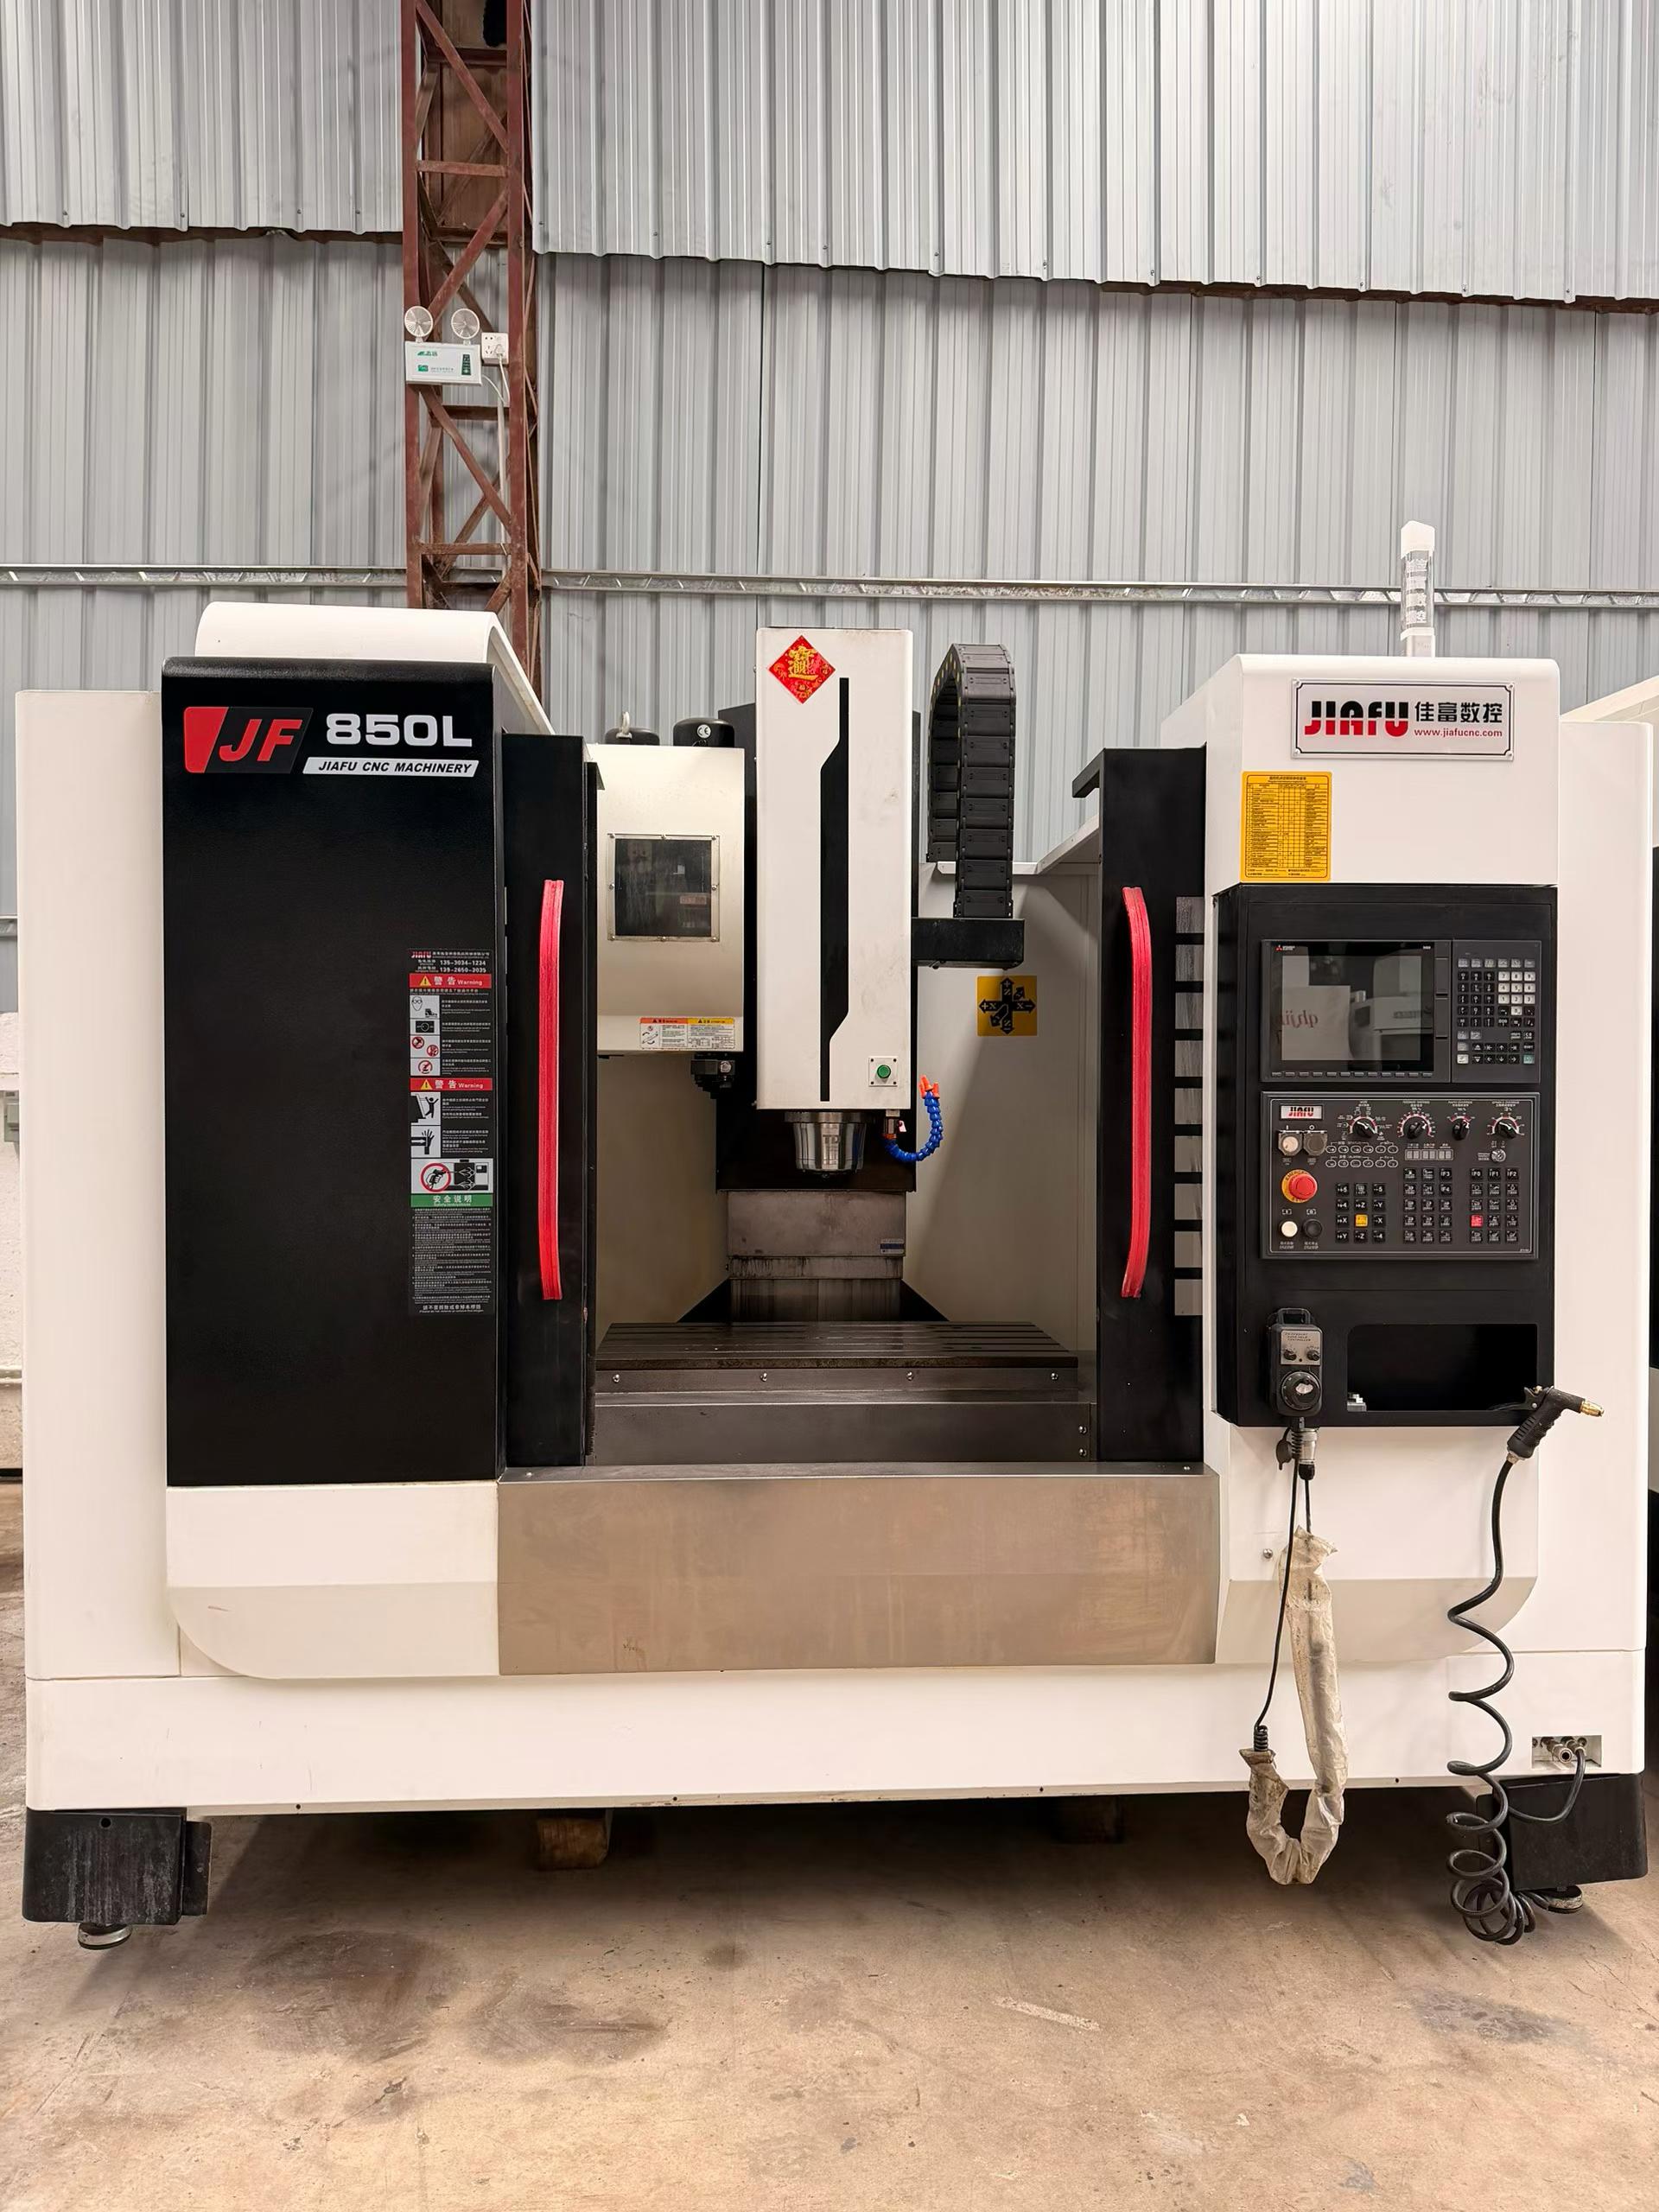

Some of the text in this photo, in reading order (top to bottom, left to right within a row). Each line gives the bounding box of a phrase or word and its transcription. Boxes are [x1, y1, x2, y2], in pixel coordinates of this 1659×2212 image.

[1305, 701, 1409, 737] JIAFU
[1414, 702, 1503, 723] 佳富数控
[219, 718, 303, 762] JF
[326, 713, 472, 747] 850L
[1414, 728, 1503, 738] www.jiafucnc.com
[318, 761, 472, 773] JIAFU CNC MACHINERY
[1288, 1107, 1313, 1116] JIAFU
